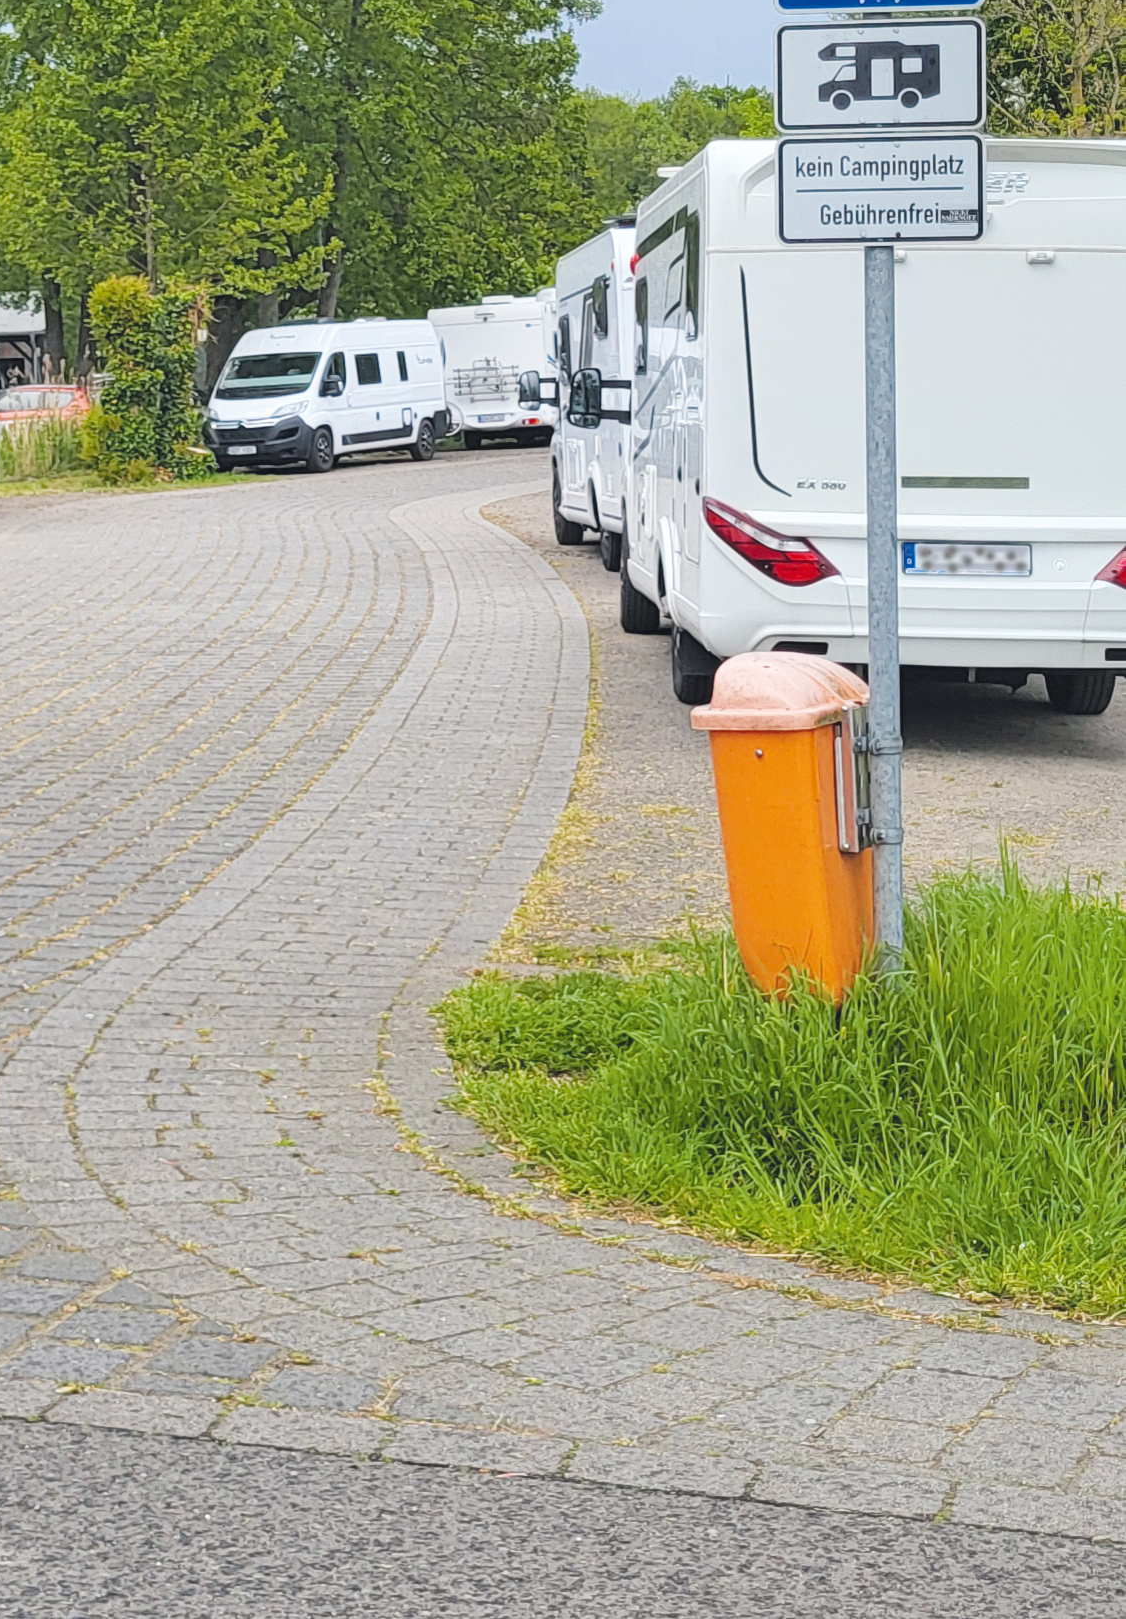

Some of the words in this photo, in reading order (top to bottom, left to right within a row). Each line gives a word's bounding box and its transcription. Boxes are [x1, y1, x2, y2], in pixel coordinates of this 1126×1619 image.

[795, 156, 834, 178] kein
[840, 153, 965, 182] Campingplatz
[820, 202, 940, 226] Gebührenfrei
[796, 478, 817, 490] EX
[821, 479, 847, 491] 580
